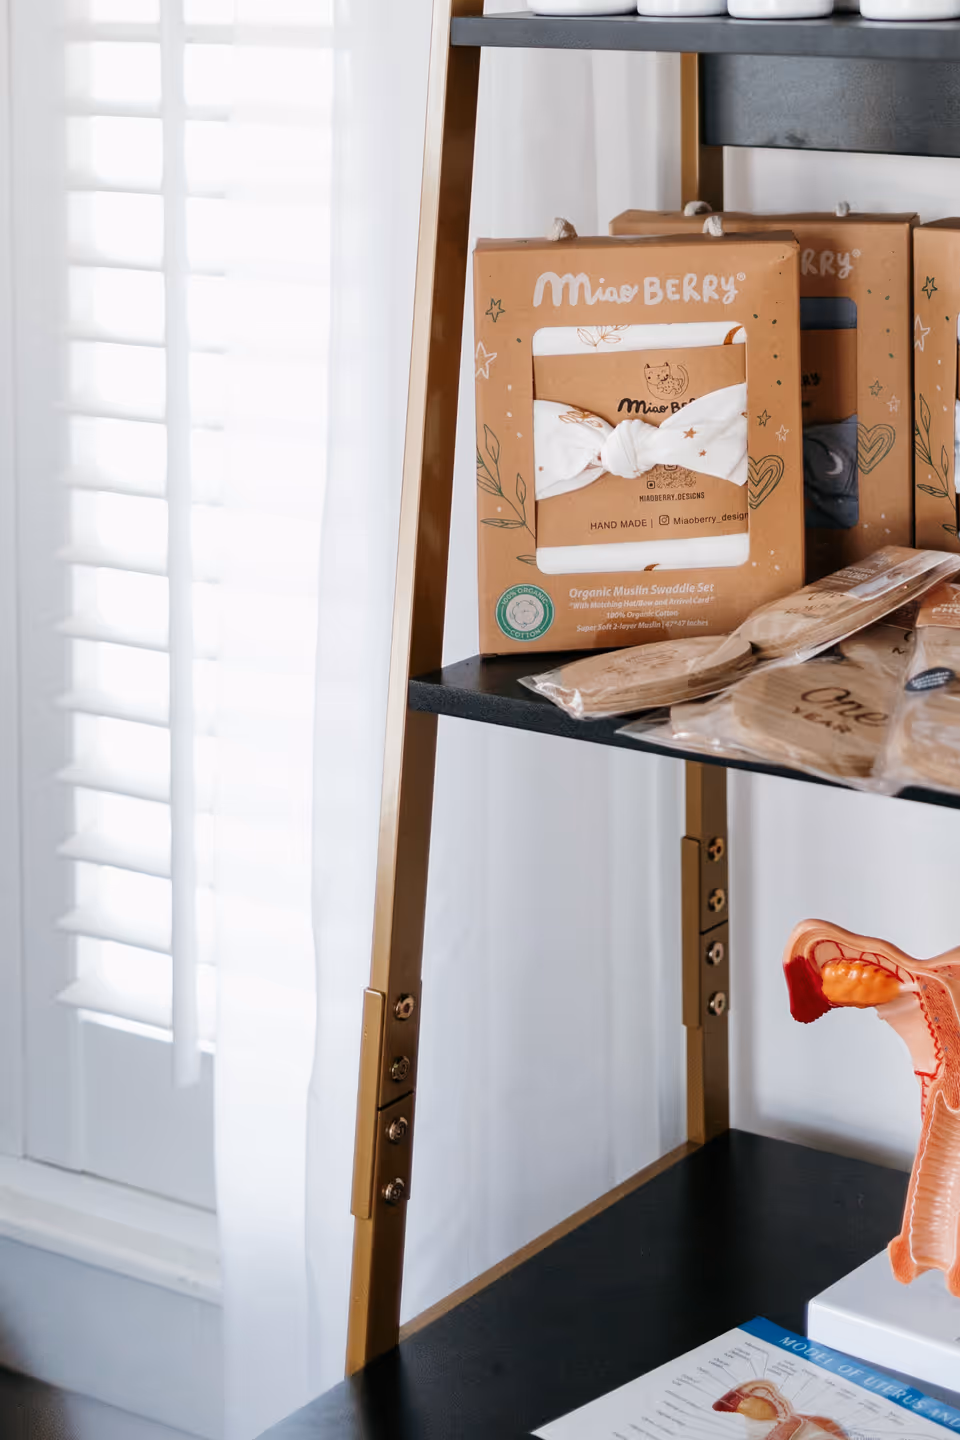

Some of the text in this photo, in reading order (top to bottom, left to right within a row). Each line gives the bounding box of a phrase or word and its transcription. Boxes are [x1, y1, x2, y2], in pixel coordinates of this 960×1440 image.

[801, 248, 853, 279] RRY
[643, 273, 739, 306] BERRY
[590, 520, 618, 530] HAND
[620, 518, 647, 529] MADE
[517, 587, 548, 604] ORGANIC
[569, 583, 714, 601] Organic Muslin Swaddle Set
[606, 609, 679, 619] 100% Organic Cotton
[510, 628, 541, 638] COTTON
[576, 624, 597, 633] Super
[637, 621, 661, 629] Muslin
[800, 687, 889, 727] One
[779, 1336, 833, 1365] MODEL
[837, 1364, 864, 1378] OF
[863, 1375, 928, 1410] UTERUS
